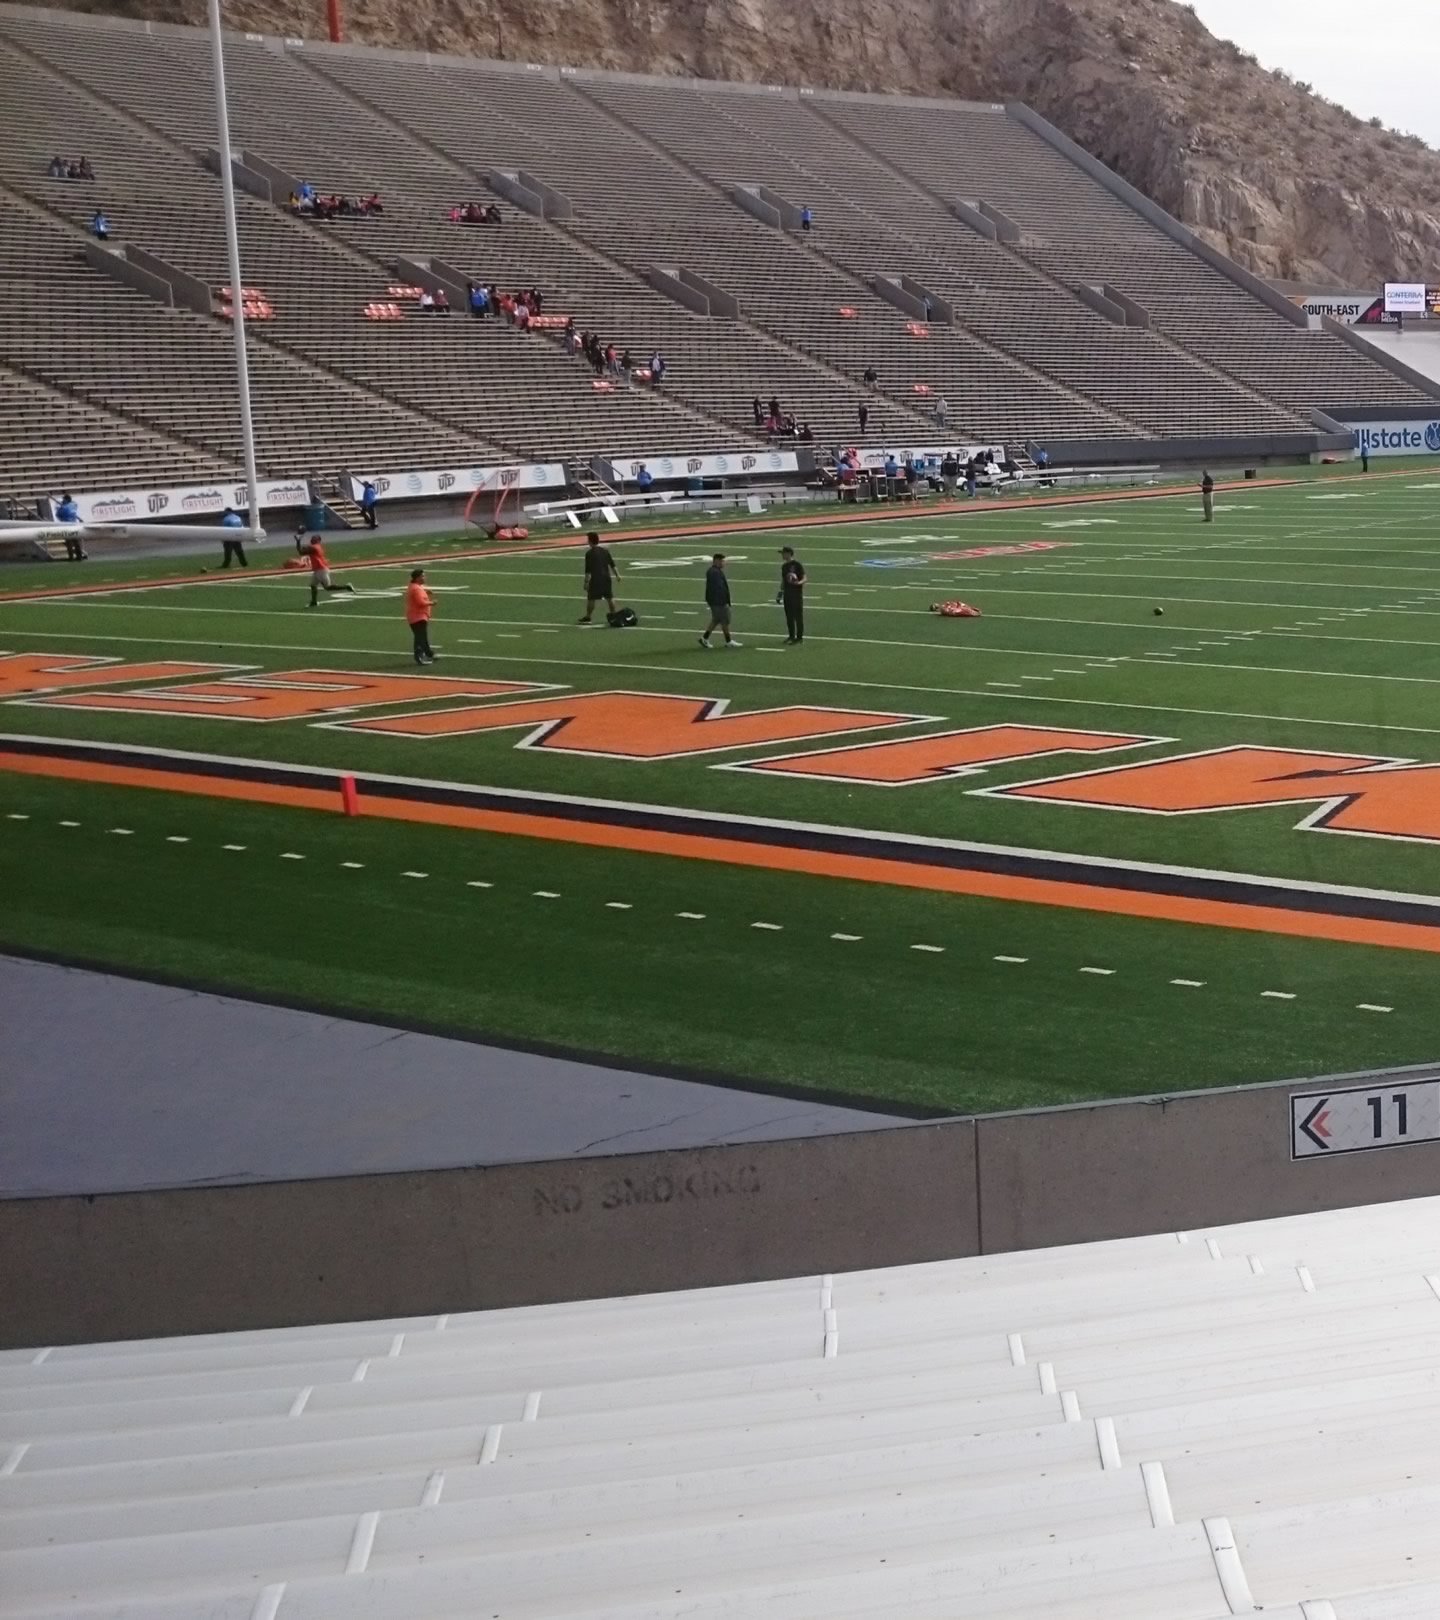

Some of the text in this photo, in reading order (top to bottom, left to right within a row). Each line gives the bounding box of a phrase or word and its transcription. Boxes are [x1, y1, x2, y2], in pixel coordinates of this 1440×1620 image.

[1303, 305, 1360, 316] SOUTH-EAST
[438, 473, 455, 490] UTEP
[148, 493, 169, 513] UTEP
[182, 498, 223, 511] FIRSTLIGHT
[235, 486, 248, 506] UT
[267, 491, 305, 503] FIRSTLIGHT
[91, 504, 136, 518] FIRSTLIGHT
[1367, 1093, 1409, 1139] 11
[534, 1164, 761, 1216] NO SMOKING
